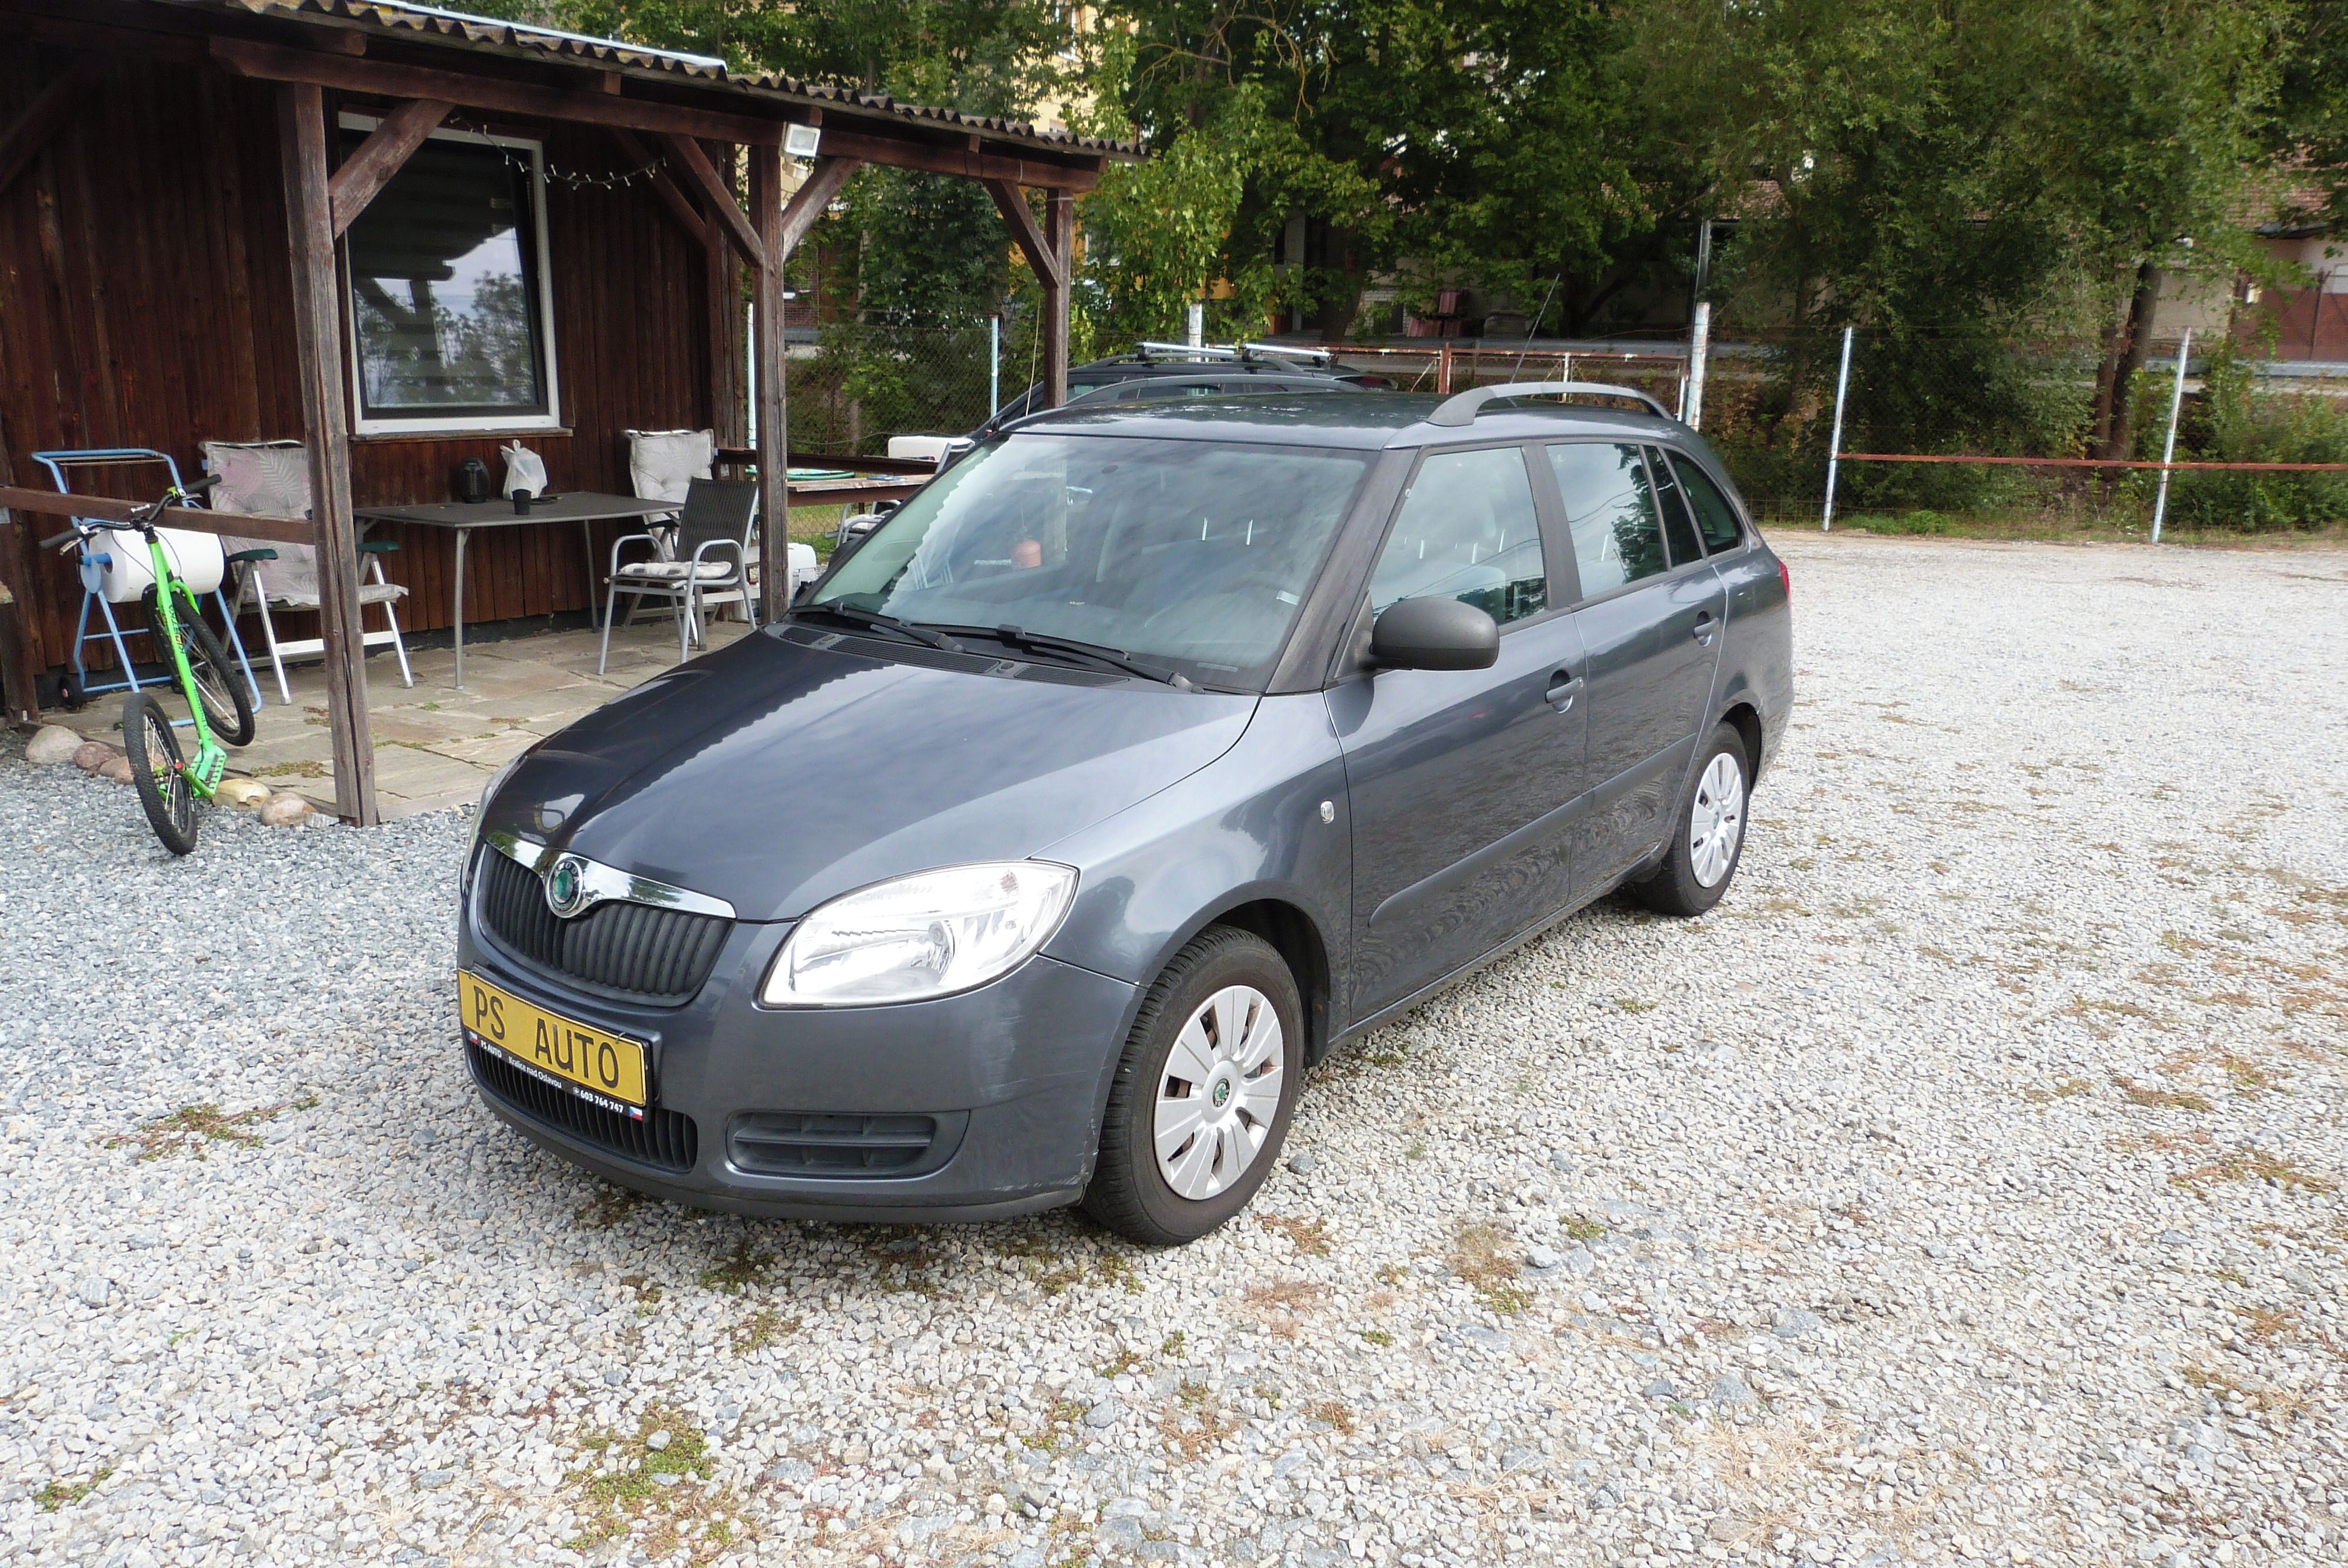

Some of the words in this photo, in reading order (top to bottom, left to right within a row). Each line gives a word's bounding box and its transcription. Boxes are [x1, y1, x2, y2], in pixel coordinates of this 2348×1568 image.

[474, 986, 505, 1040] PS
[535, 1018, 619, 1088] AUTO
[487, 1045, 502, 1057] AUTO
[527, 1066, 537, 1077] nad
[581, 1090, 593, 1101] 603
[595, 1096, 608, 1108] 764
[609, 1101, 623, 1113] 747
